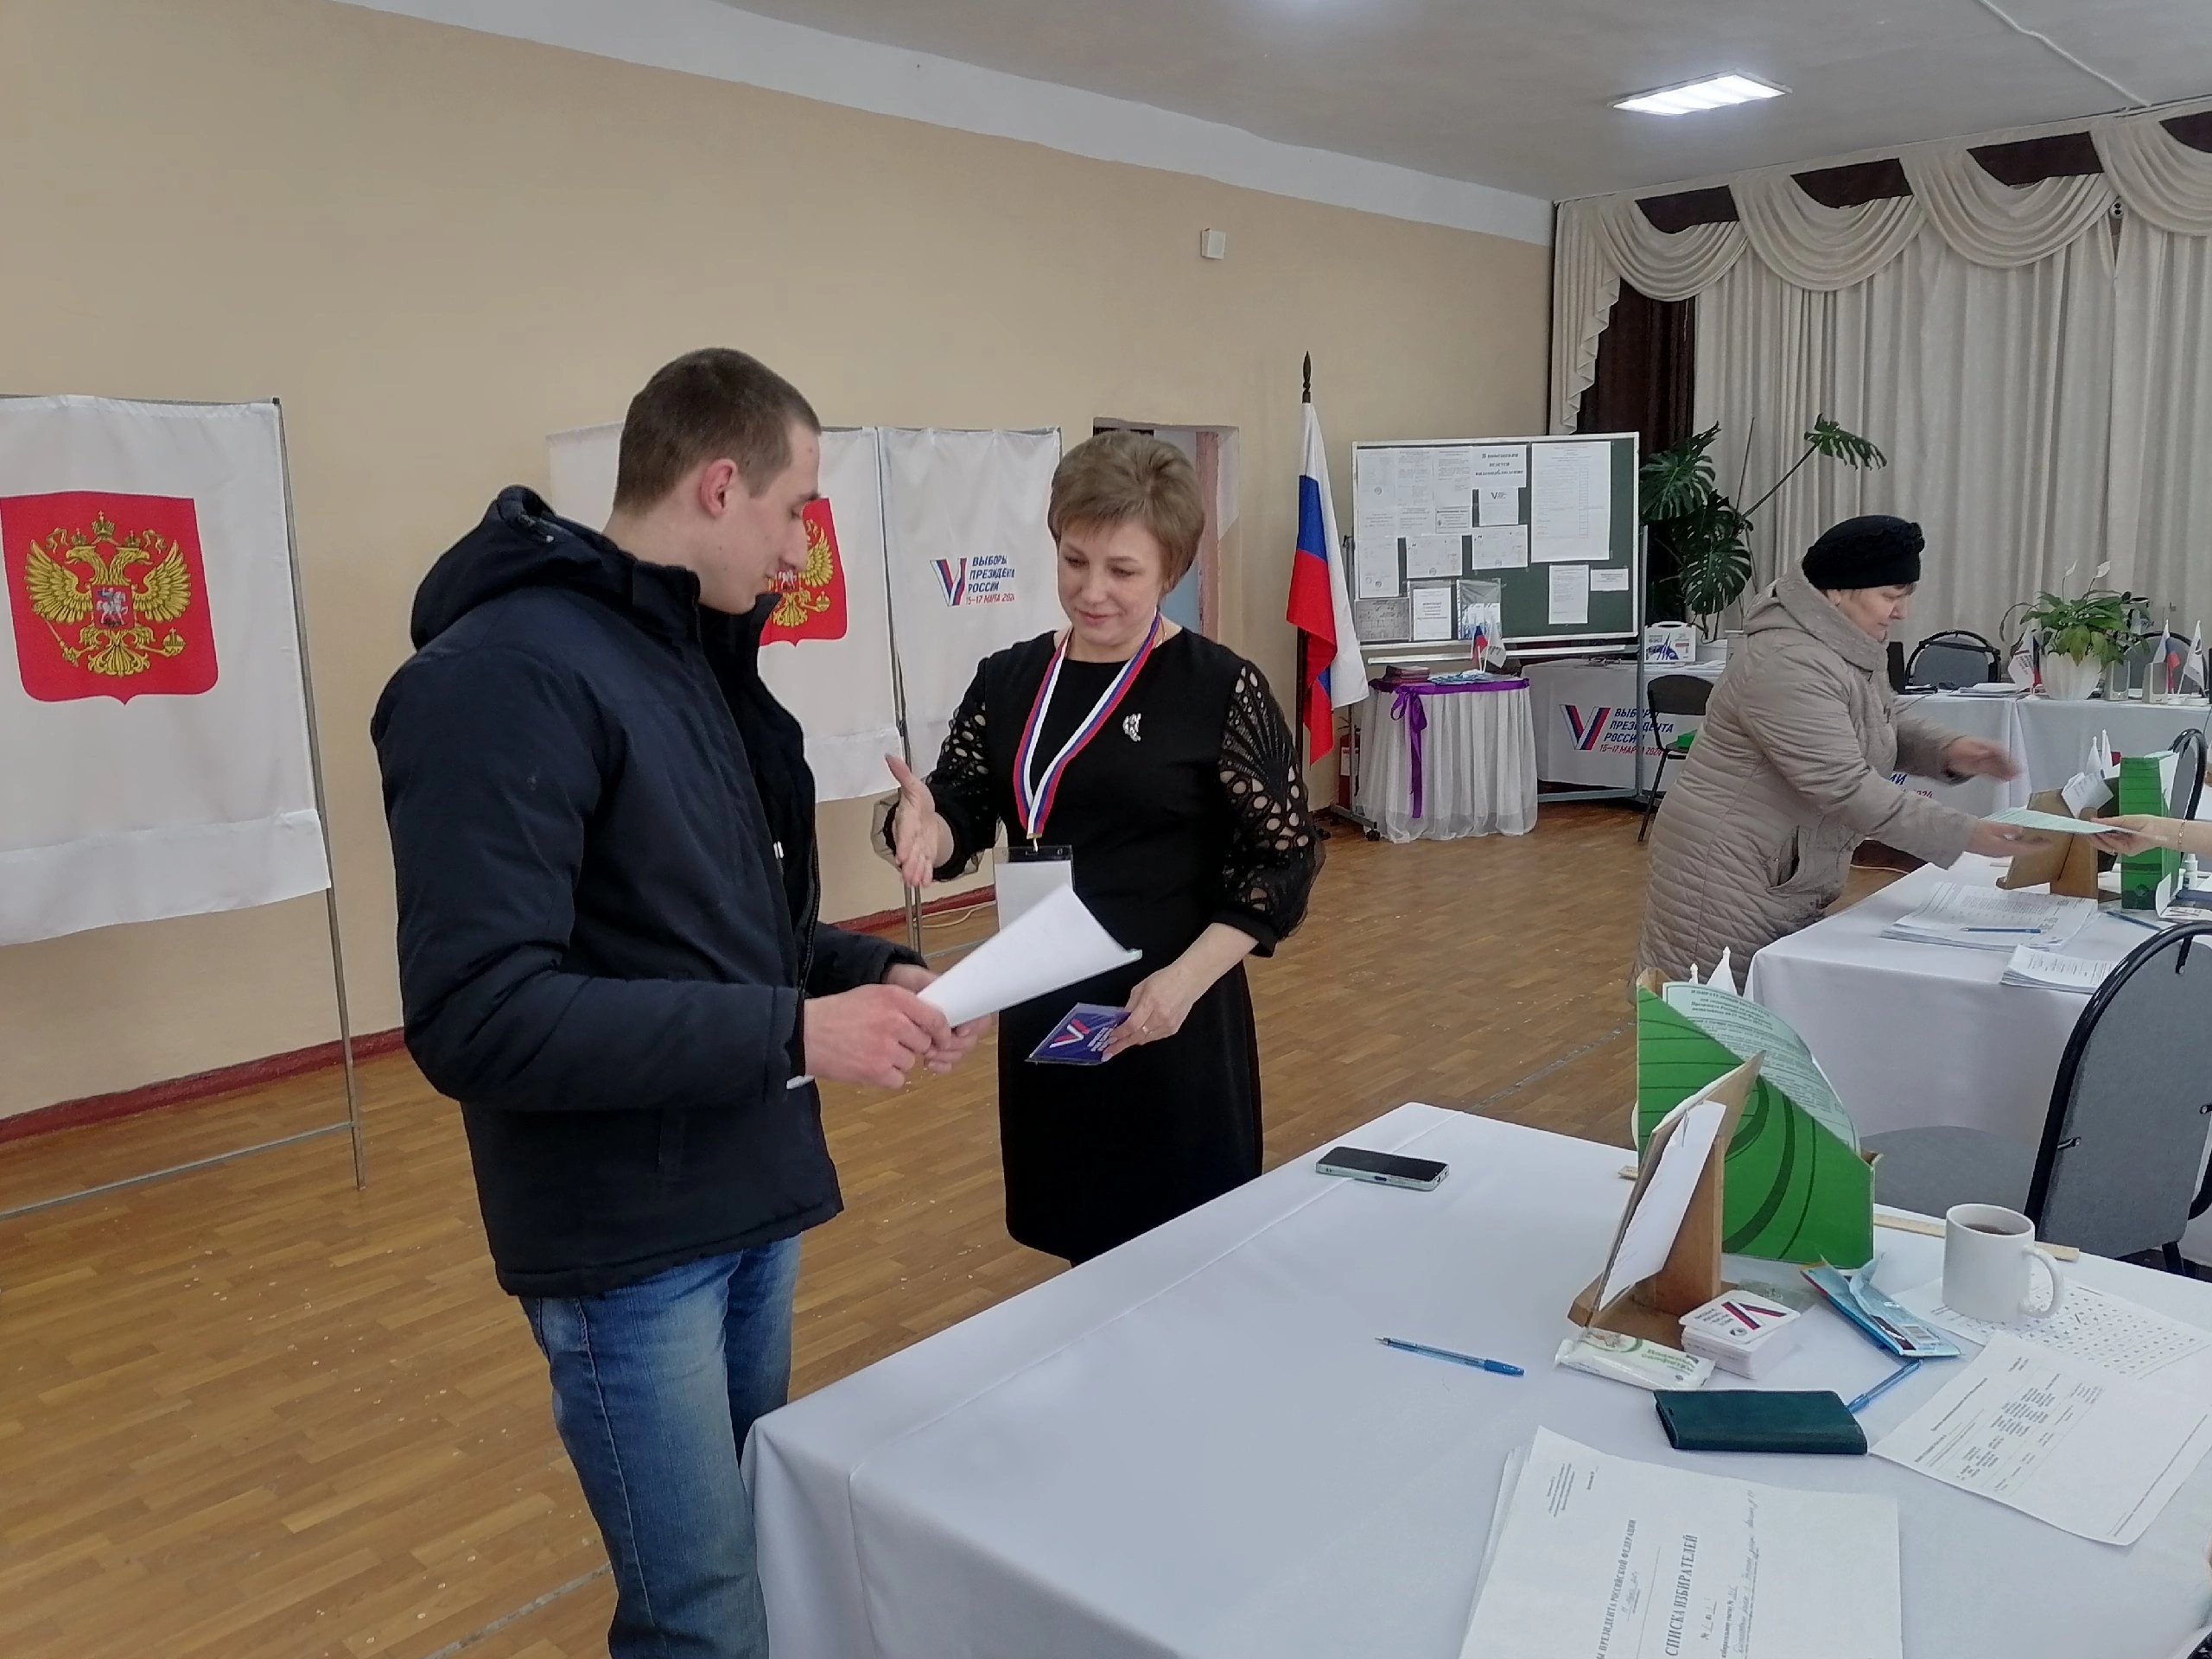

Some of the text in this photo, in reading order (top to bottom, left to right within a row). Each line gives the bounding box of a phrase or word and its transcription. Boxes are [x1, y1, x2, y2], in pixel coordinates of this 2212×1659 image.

[971, 555, 1007, 567] ВЫБОРЫ
[967, 582, 1000, 594] РОССИИ
[1614, 708, 1659, 719] ВЫБР
[1609, 720, 1675, 734] ПРЕЗДЕНТА
[1604, 733, 1645, 743] РОССИ
[1619, 746, 1644, 754] МАР
[1664, 1534, 1698, 1657] СПИСКА ИЗБИРАТЕЛЕЙ
[1598, 1603, 1618, 1651] ПРЕЗИДЕНТА
